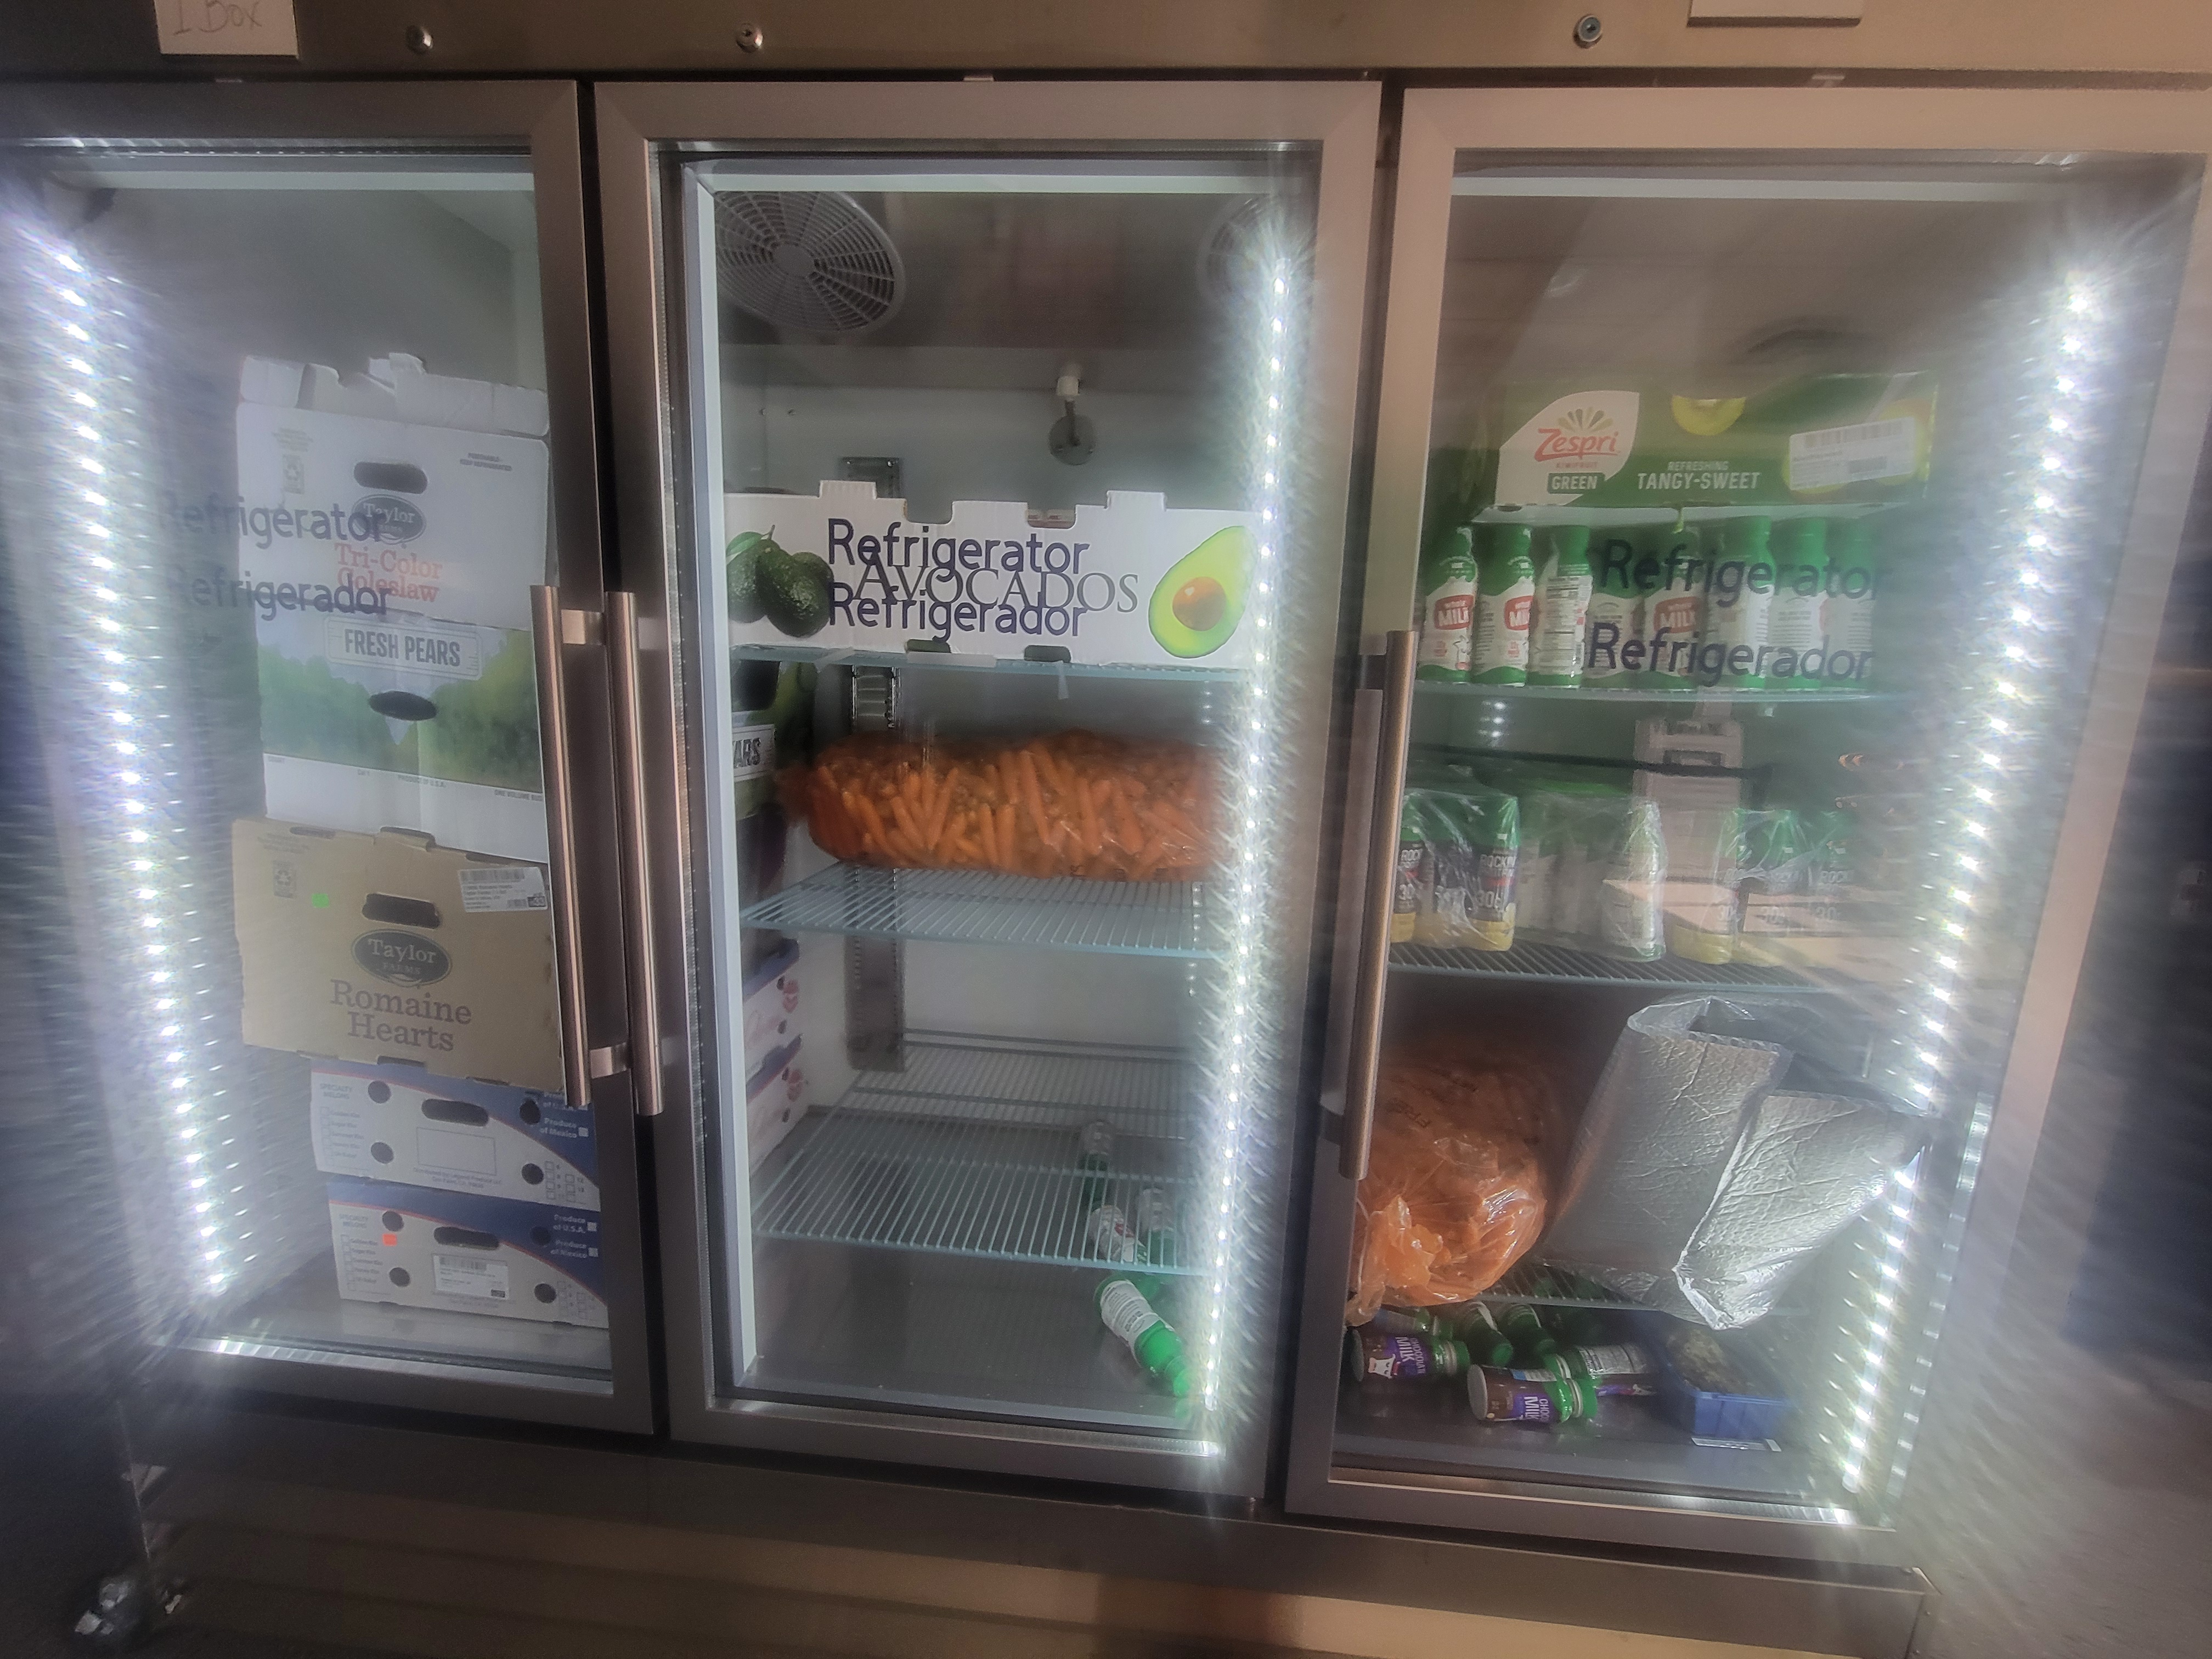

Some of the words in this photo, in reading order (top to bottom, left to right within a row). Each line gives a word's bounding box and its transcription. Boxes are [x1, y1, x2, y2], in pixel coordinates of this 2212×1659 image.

[1534, 427, 1620, 462] Zespri
[1551, 475, 1598, 490] GREEN
[1637, 472, 1762, 489] TANGY-SWEET
[334, 542, 443, 579] Tri-Color
[828, 518, 1091, 583] Refrigerator
[337, 567, 441, 603] Coleslaw
[852, 548, 1139, 613] AVOCADOS
[829, 582, 1089, 642] Refrigerador
[343, 628, 399, 659] FRESH
[404, 635, 461, 667] PEARS
[1588, 622, 1877, 688] Refrigerador
[368, 938, 437, 963] Taylor
[383, 962, 421, 975] FARMS
[330, 979, 472, 1025] Romaine
[347, 1010, 454, 1052] Hearts
[1395, 1336, 1415, 1362] MILK
[1523, 1396, 1541, 1420] MILK
